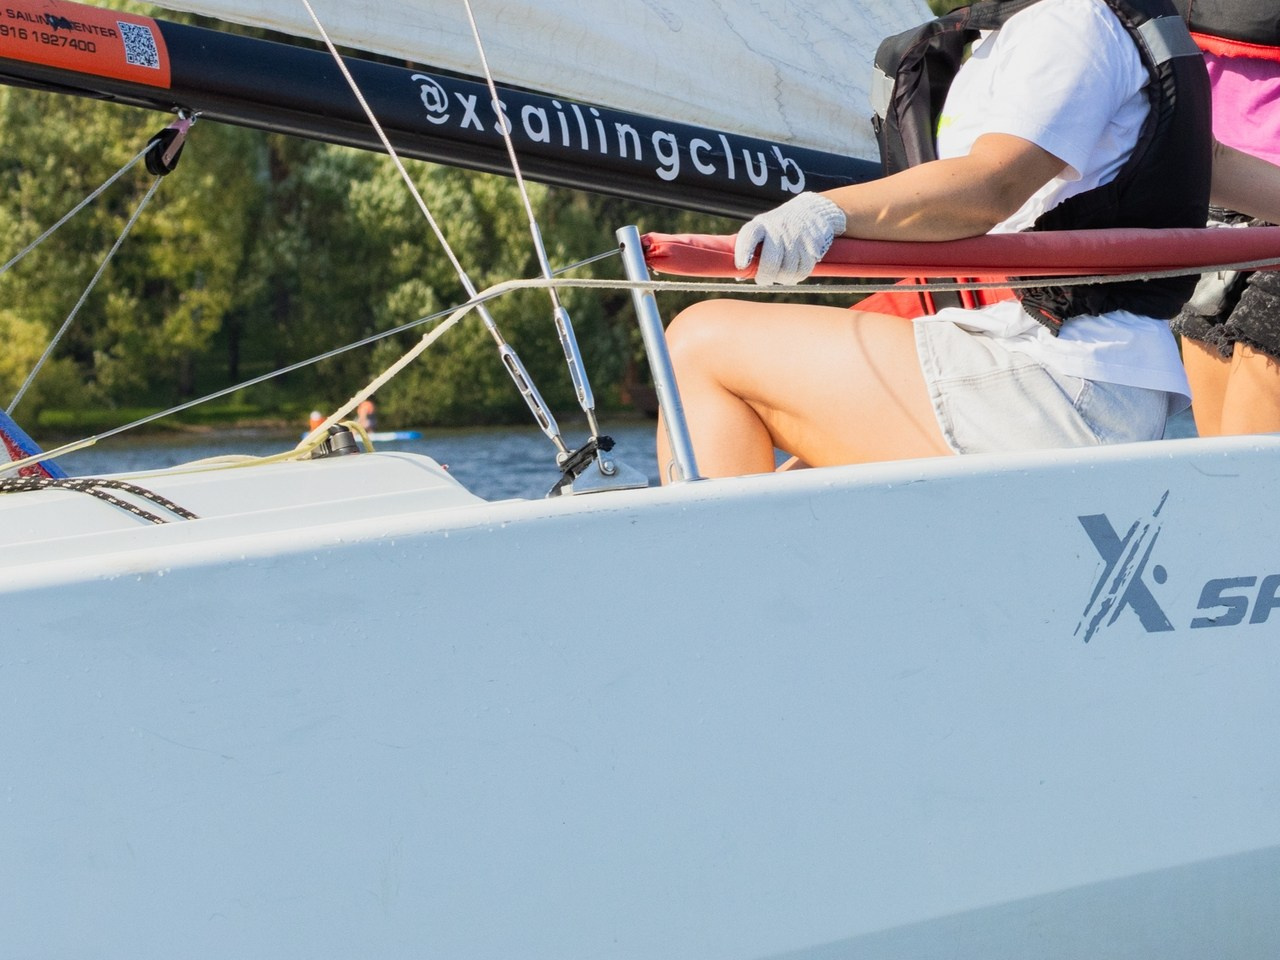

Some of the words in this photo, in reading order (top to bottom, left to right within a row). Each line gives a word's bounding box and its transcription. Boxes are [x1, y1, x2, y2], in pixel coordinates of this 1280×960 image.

[6, 7, 58, 28] SAILIN
[64, 19, 118, 38] ENTER
[32, 30, 97, 53] 1927400
[410, 72, 807, 194] @xsailingclub
